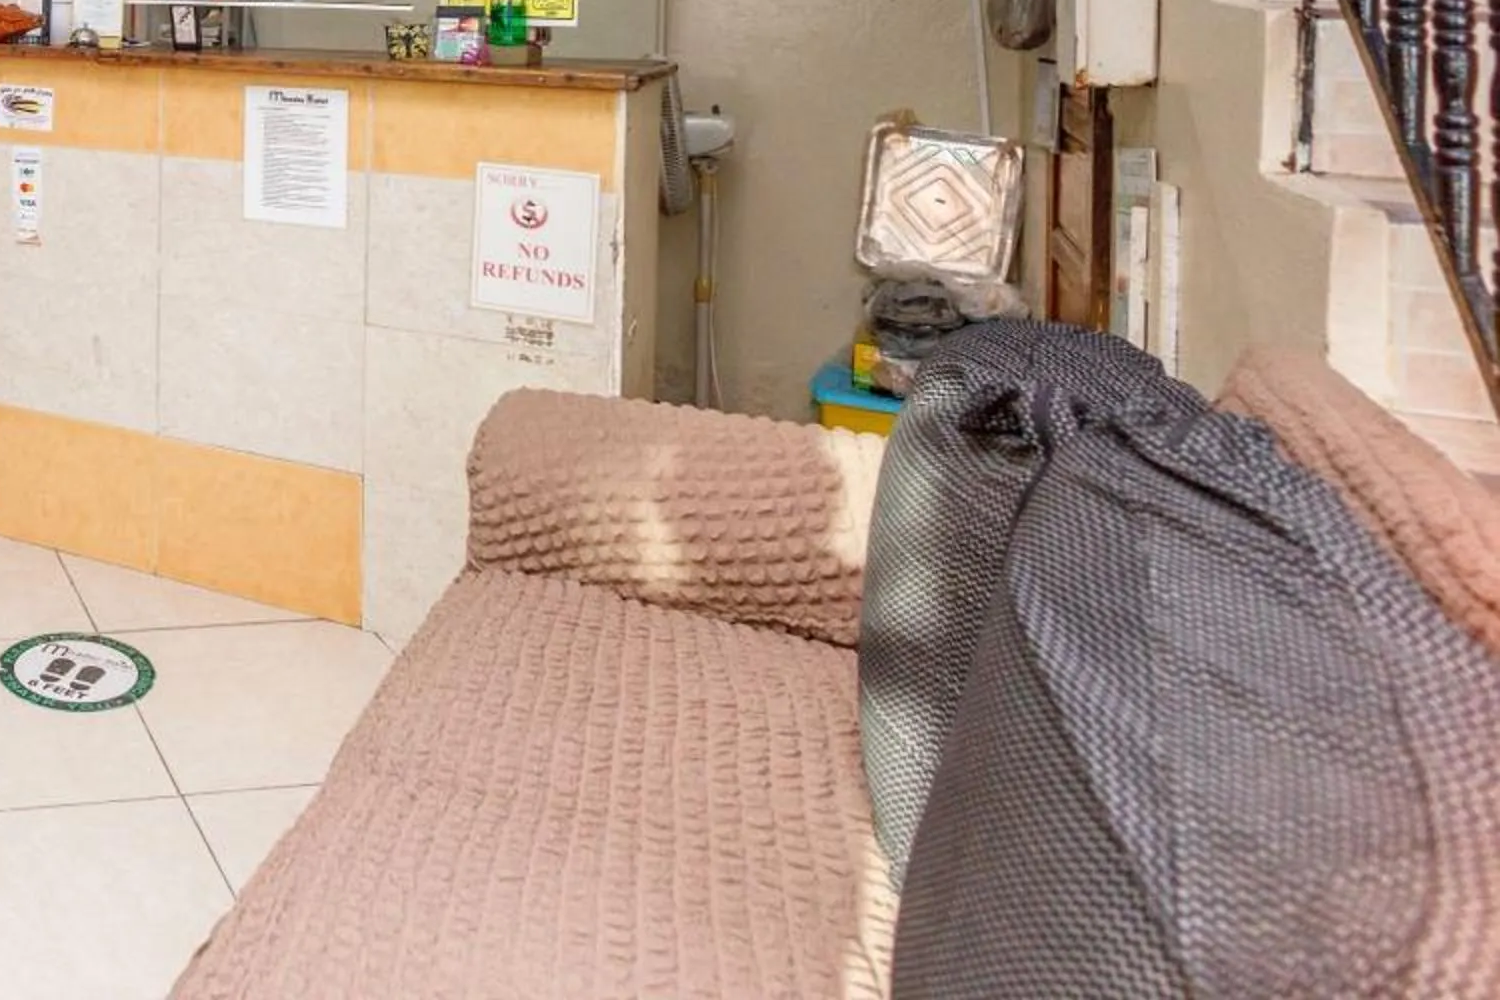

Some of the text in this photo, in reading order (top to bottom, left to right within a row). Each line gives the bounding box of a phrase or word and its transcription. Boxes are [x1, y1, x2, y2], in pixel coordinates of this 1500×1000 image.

[518, 242, 550, 261] NO
[482, 261, 586, 290] REFUNDS
[42, 683, 89, 700] FEET
